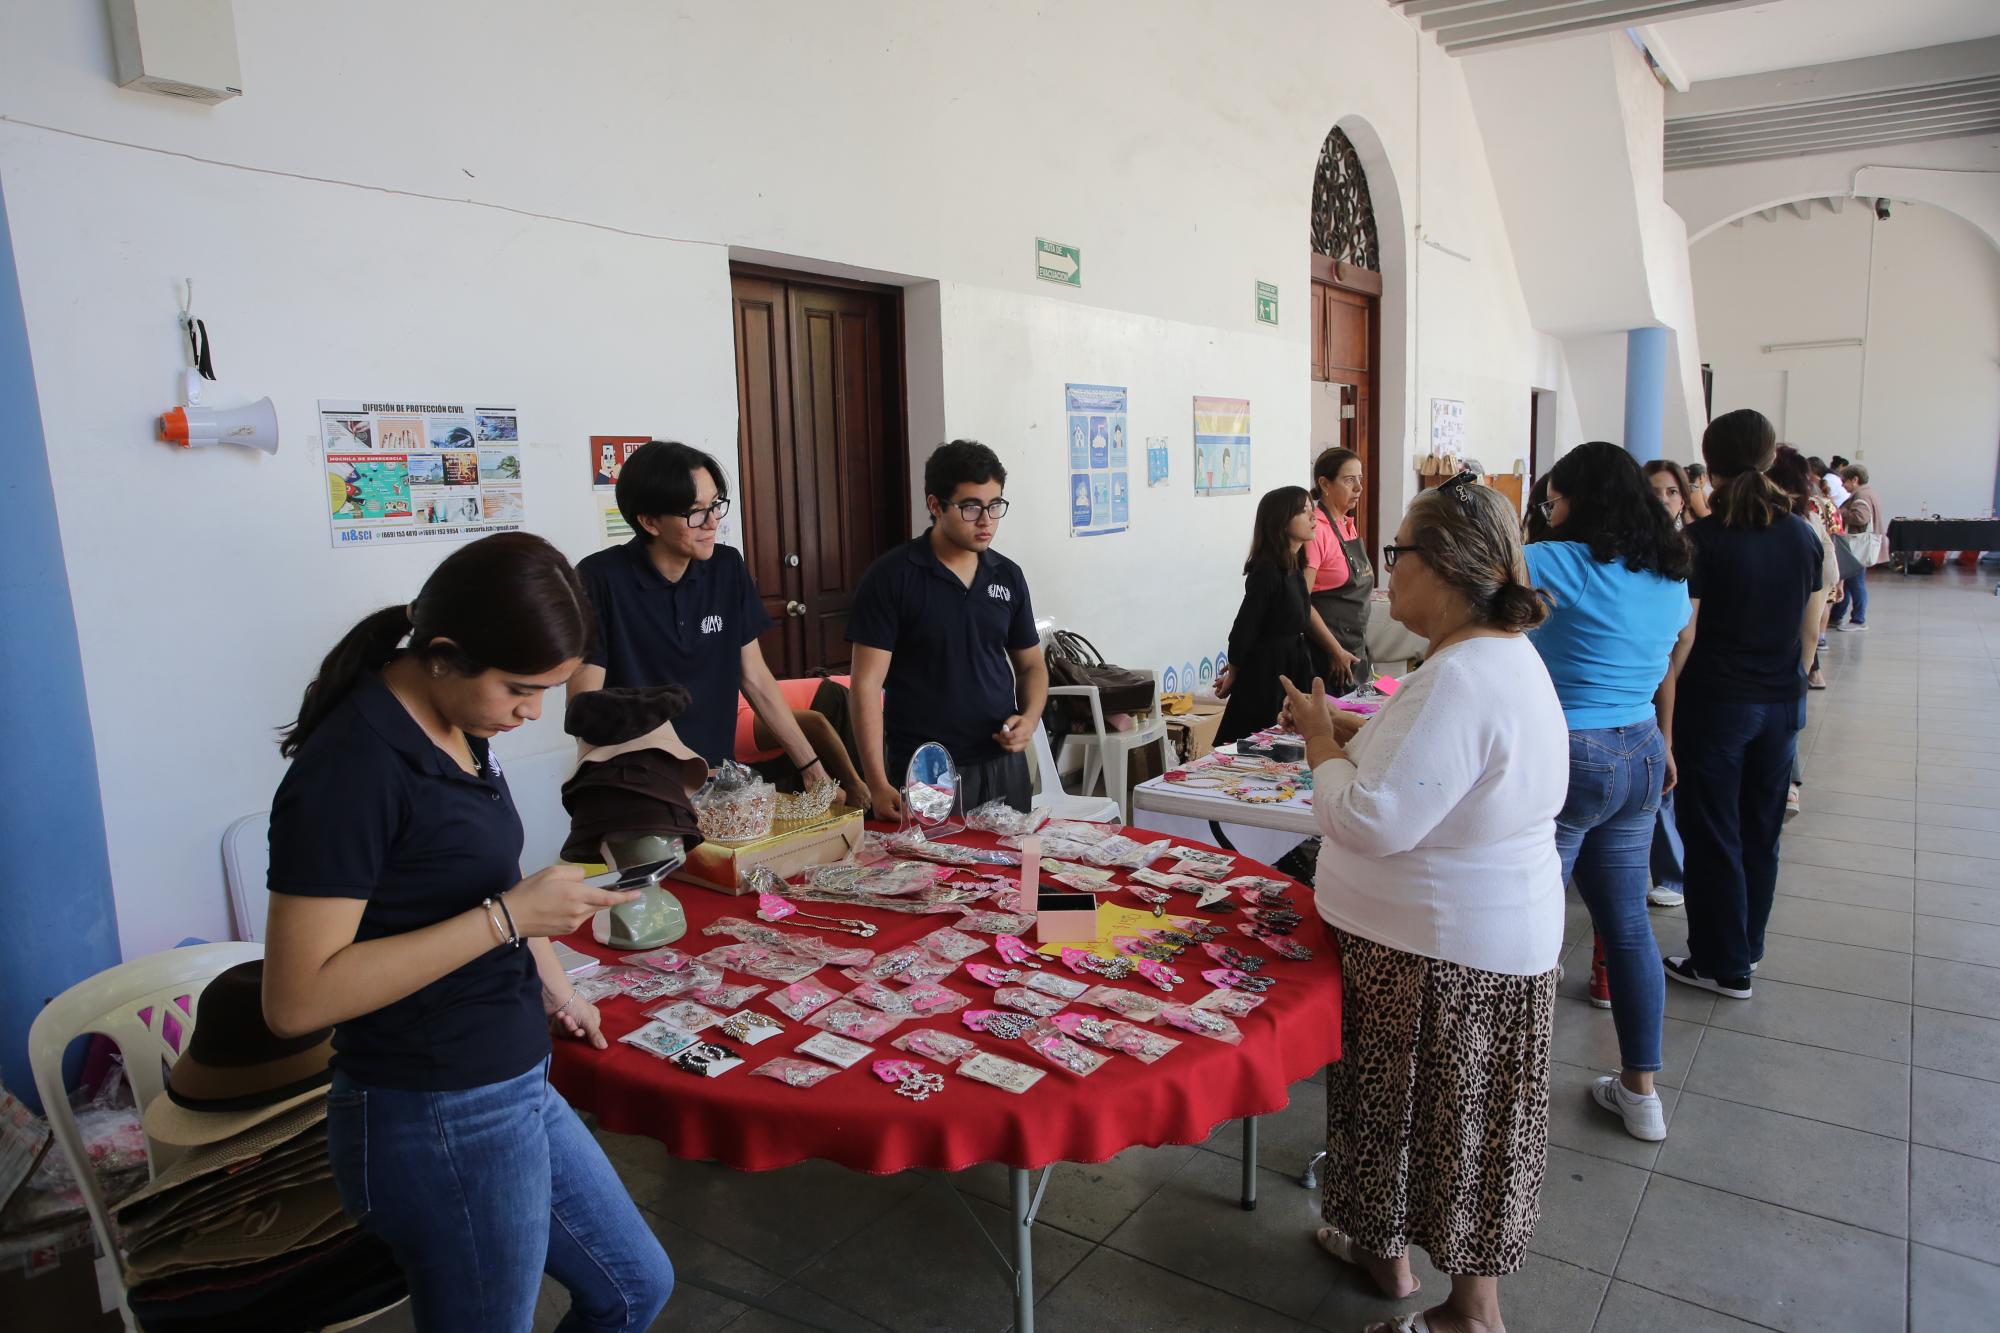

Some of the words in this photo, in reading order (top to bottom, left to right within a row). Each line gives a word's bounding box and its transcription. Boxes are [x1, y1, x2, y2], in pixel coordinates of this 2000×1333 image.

[362, 402, 395, 412] DIFUSIÓN
[396, 404, 404, 412] DE
[405, 404, 447, 413] PROTECCIÓN
[447, 405, 464, 413] CIVIL
